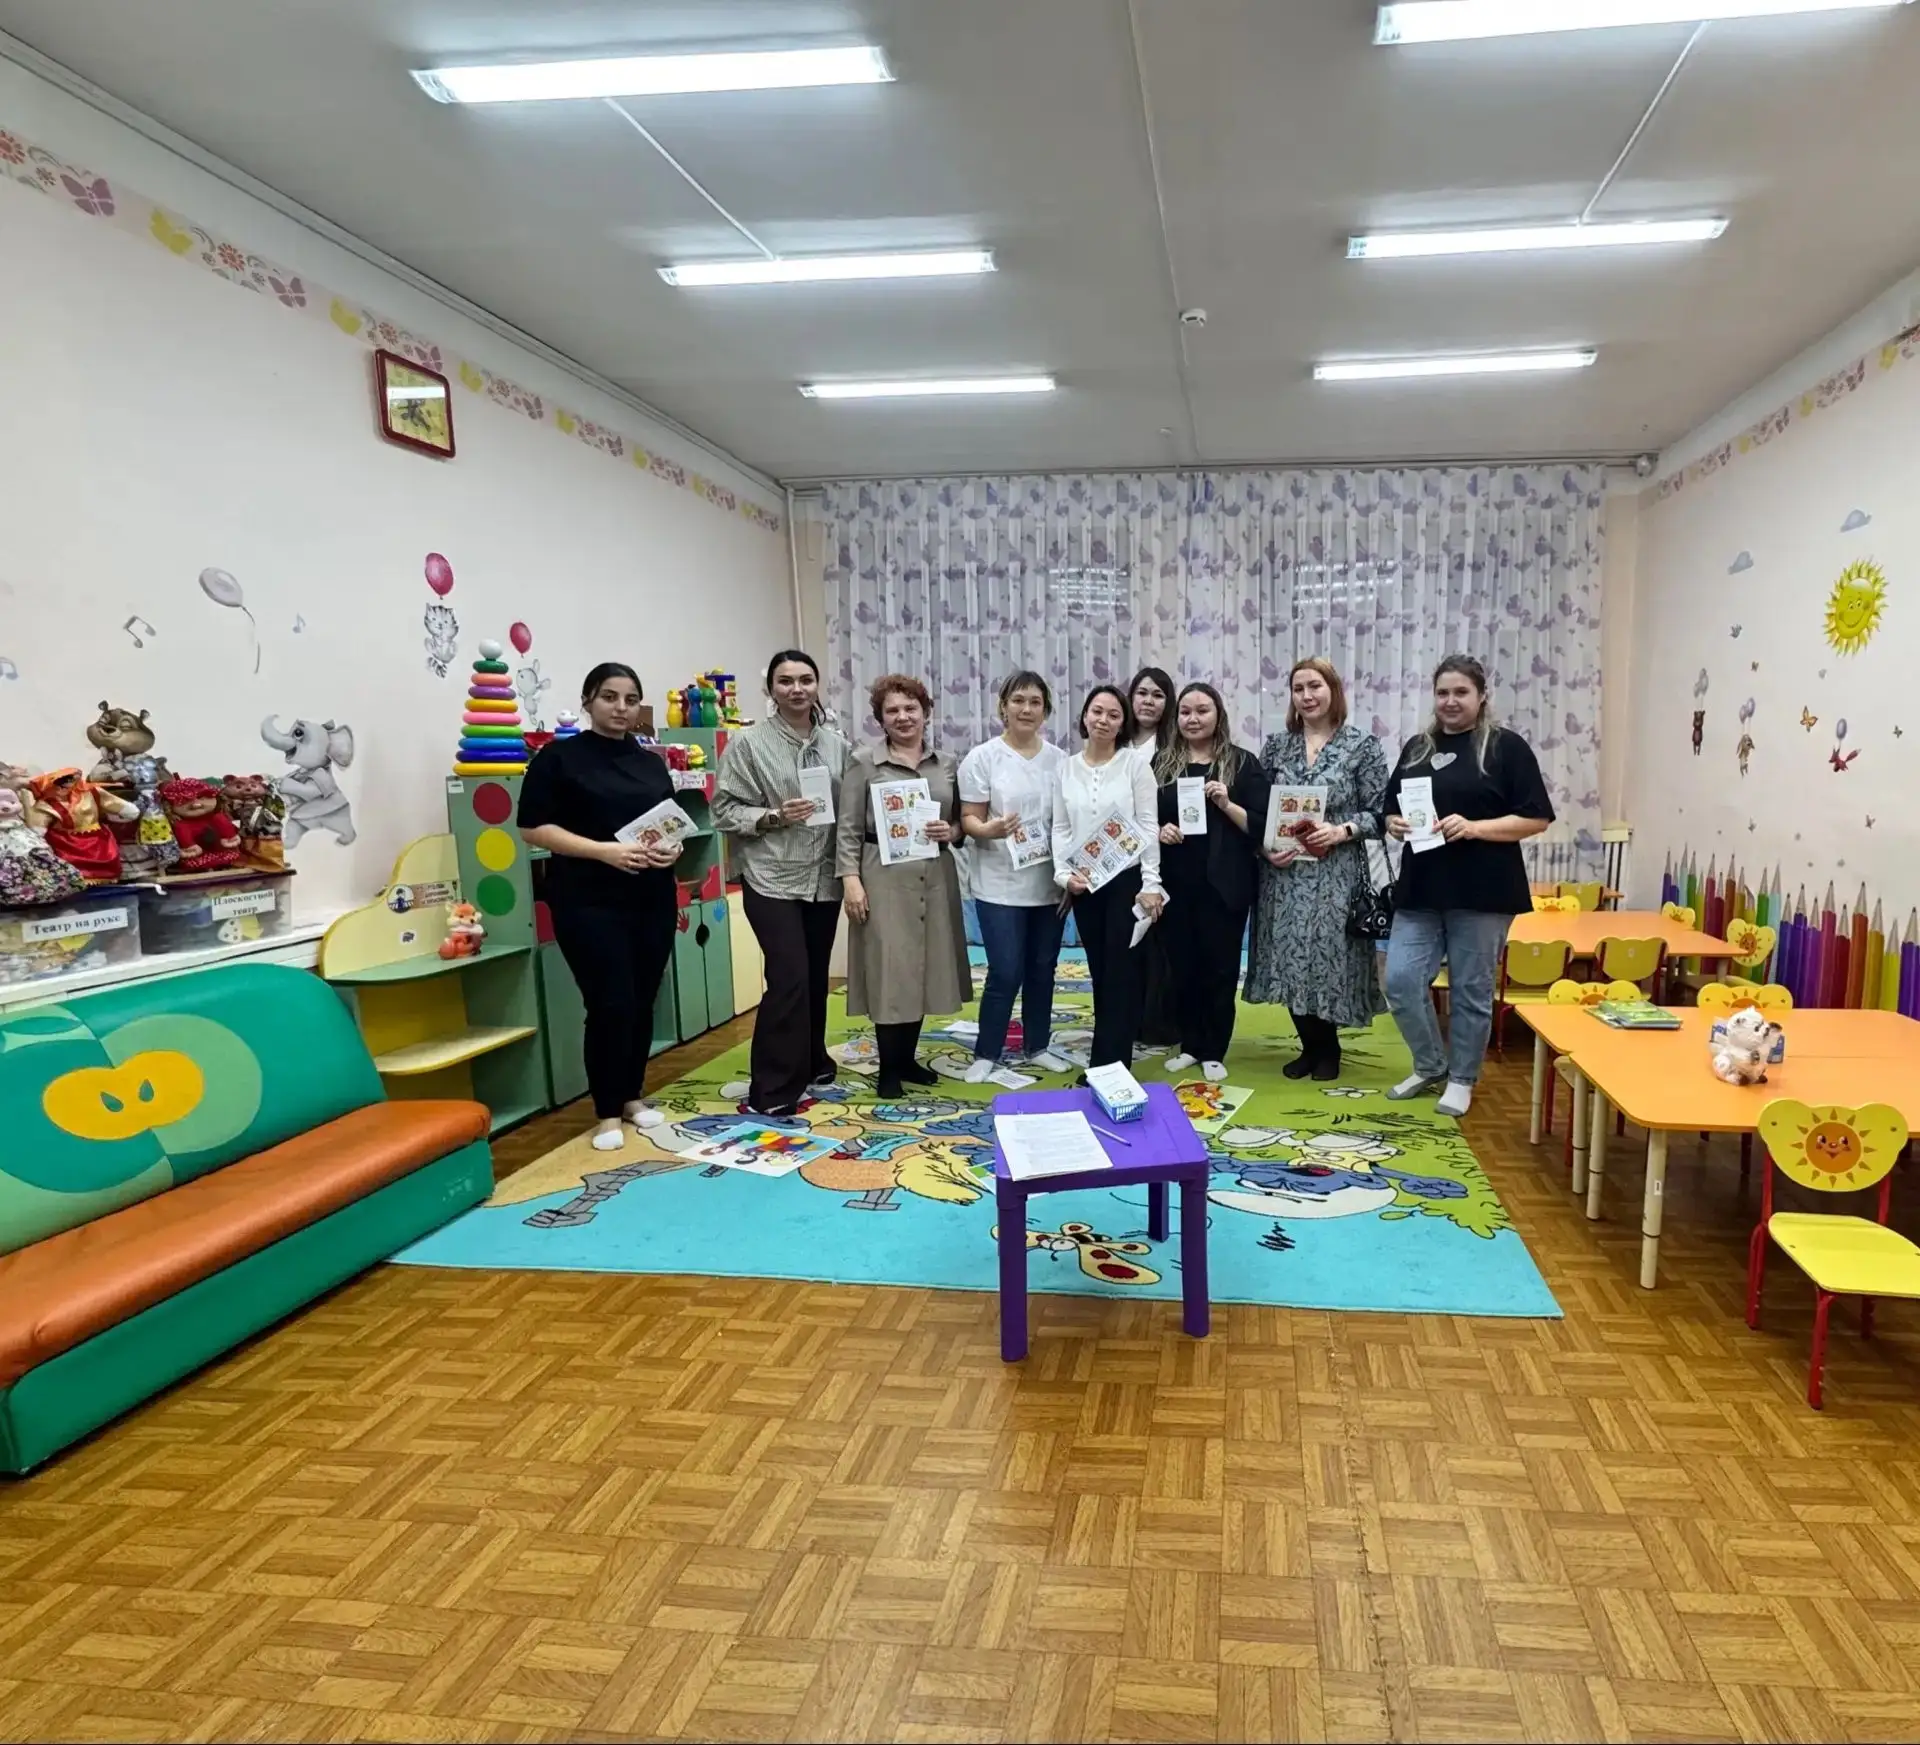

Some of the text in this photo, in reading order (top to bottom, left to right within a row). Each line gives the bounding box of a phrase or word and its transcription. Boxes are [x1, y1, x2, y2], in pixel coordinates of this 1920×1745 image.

[232, 906, 258, 915] театр
[31, 914, 121, 935] Театр на руке
